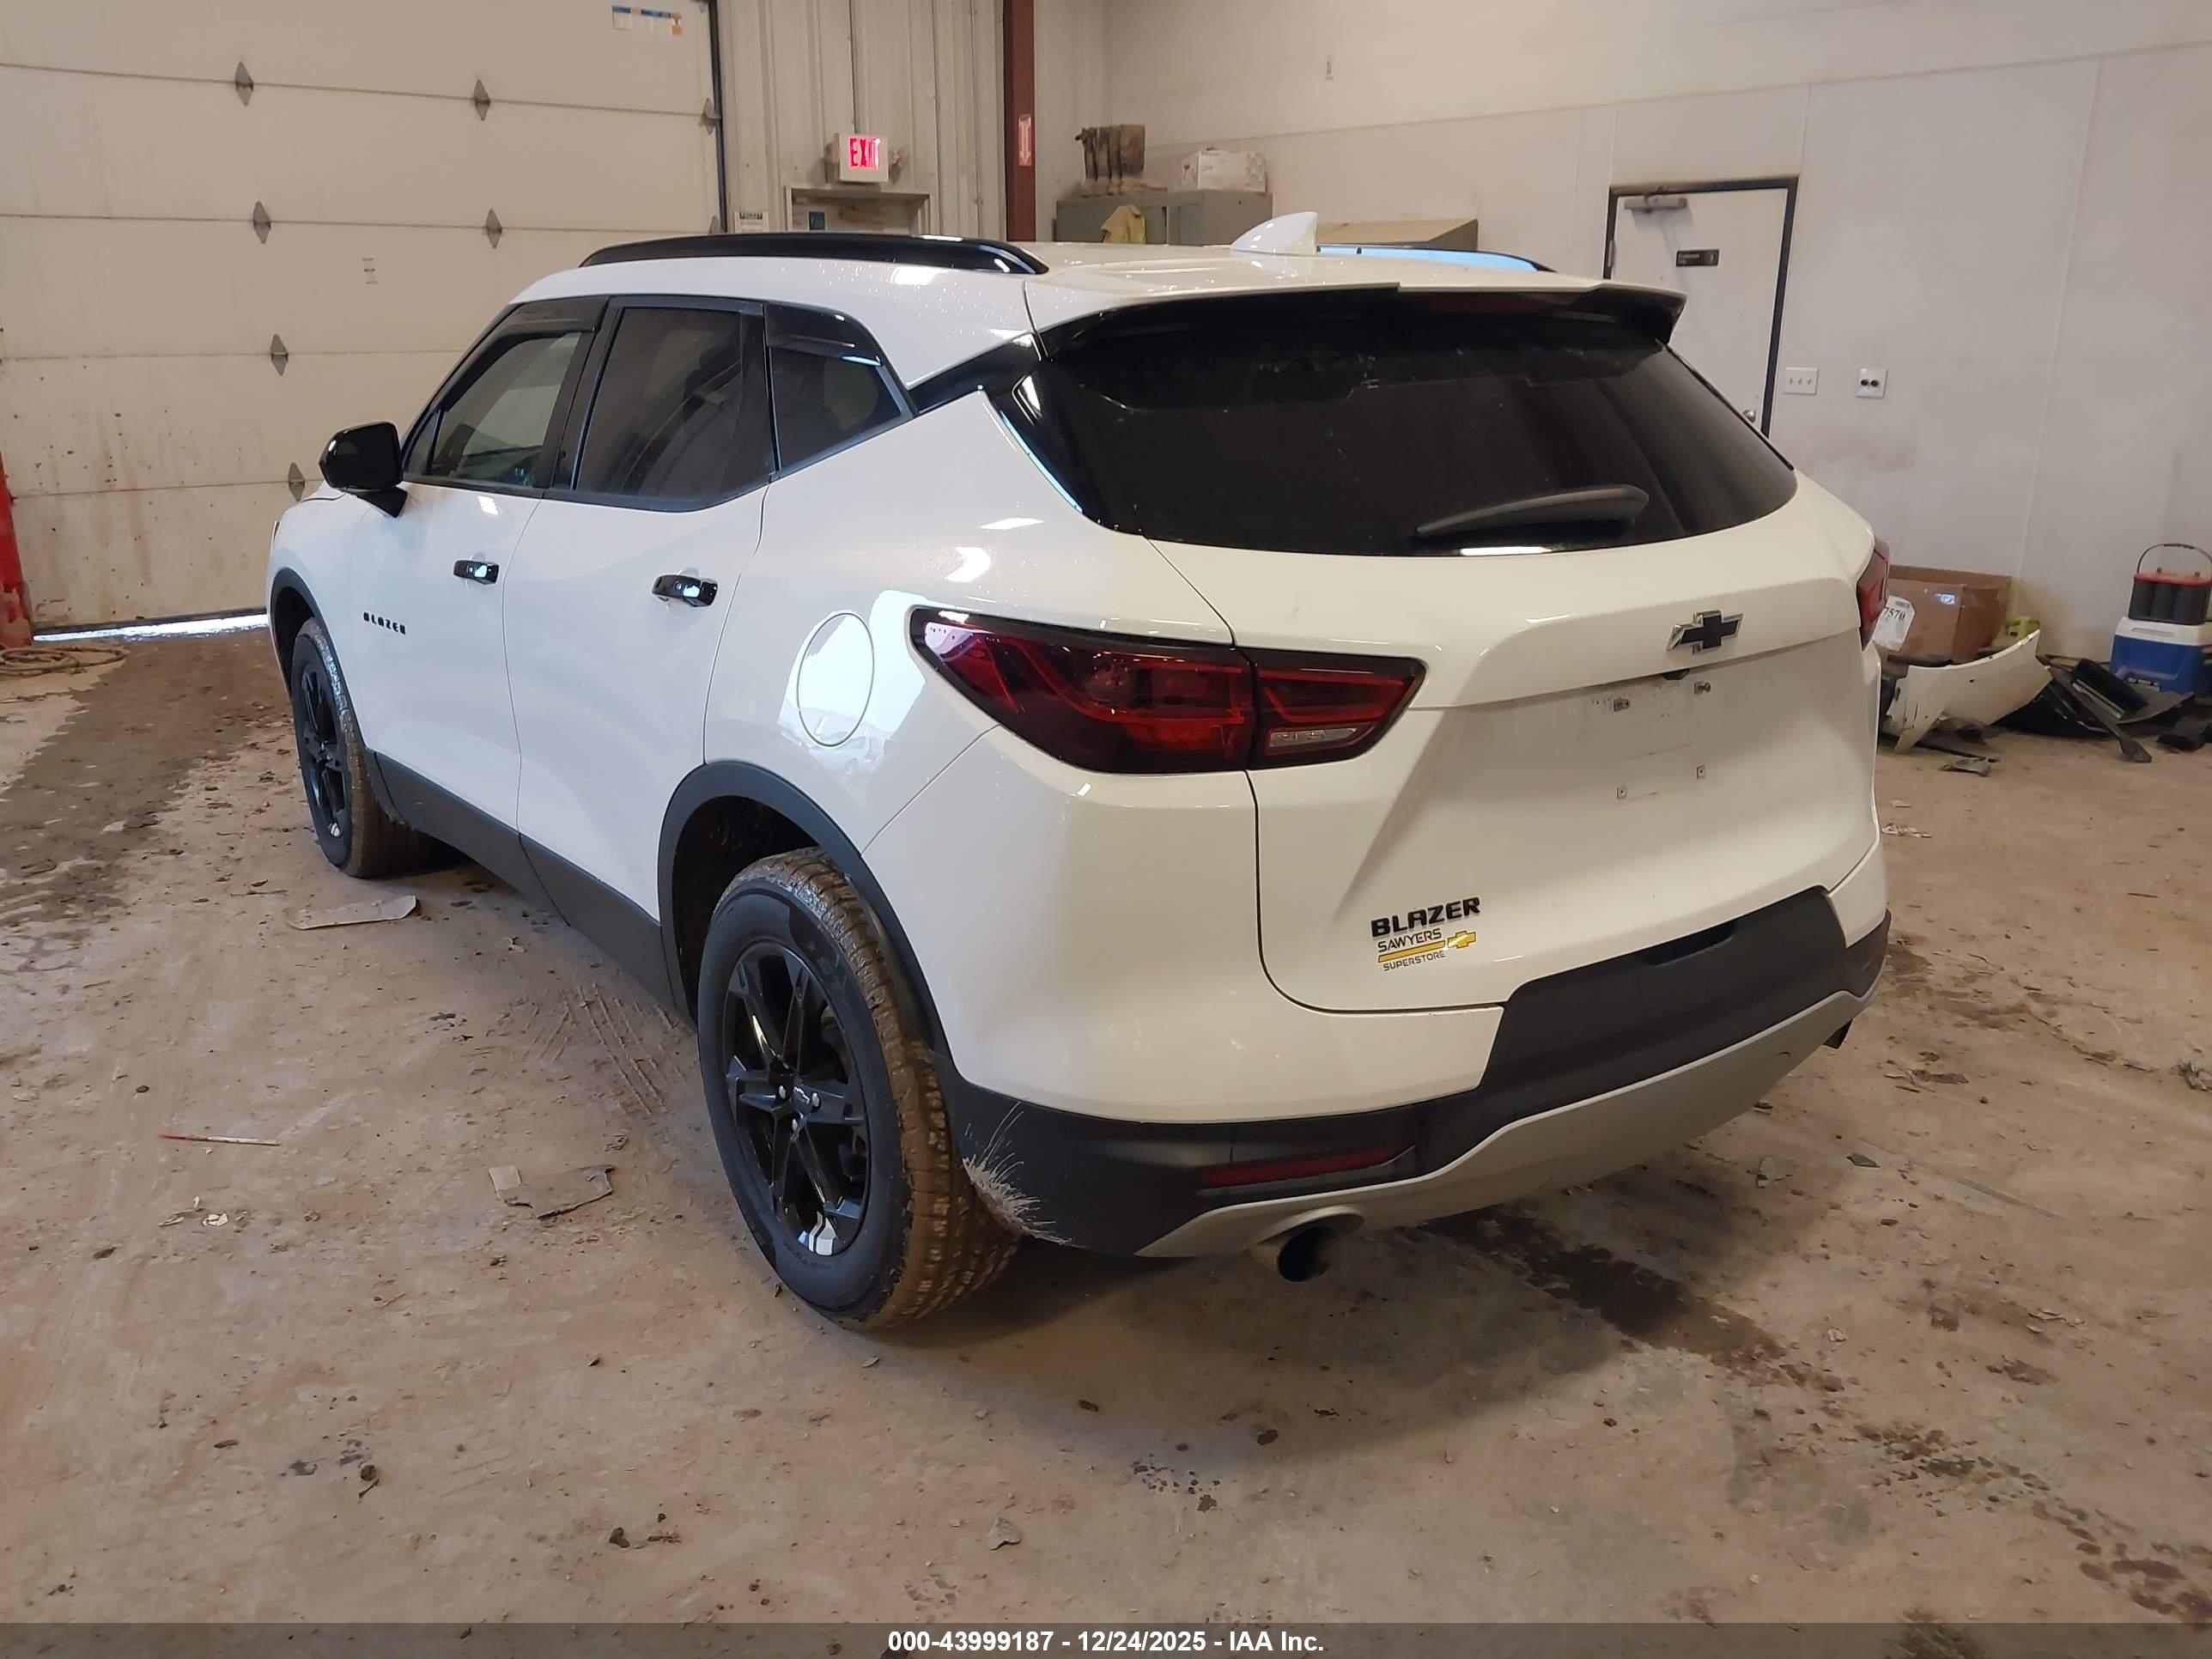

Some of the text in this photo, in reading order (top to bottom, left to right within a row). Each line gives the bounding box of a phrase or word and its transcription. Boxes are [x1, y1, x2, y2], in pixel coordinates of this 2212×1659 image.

[849, 137, 880, 167] EXIT
[363, 611, 406, 635] BLAZER
[1371, 896, 1480, 938] BLAZER
[1377, 927, 1443, 953] SAWYERS
[1382, 950, 1446, 971] SUPERSTORE
